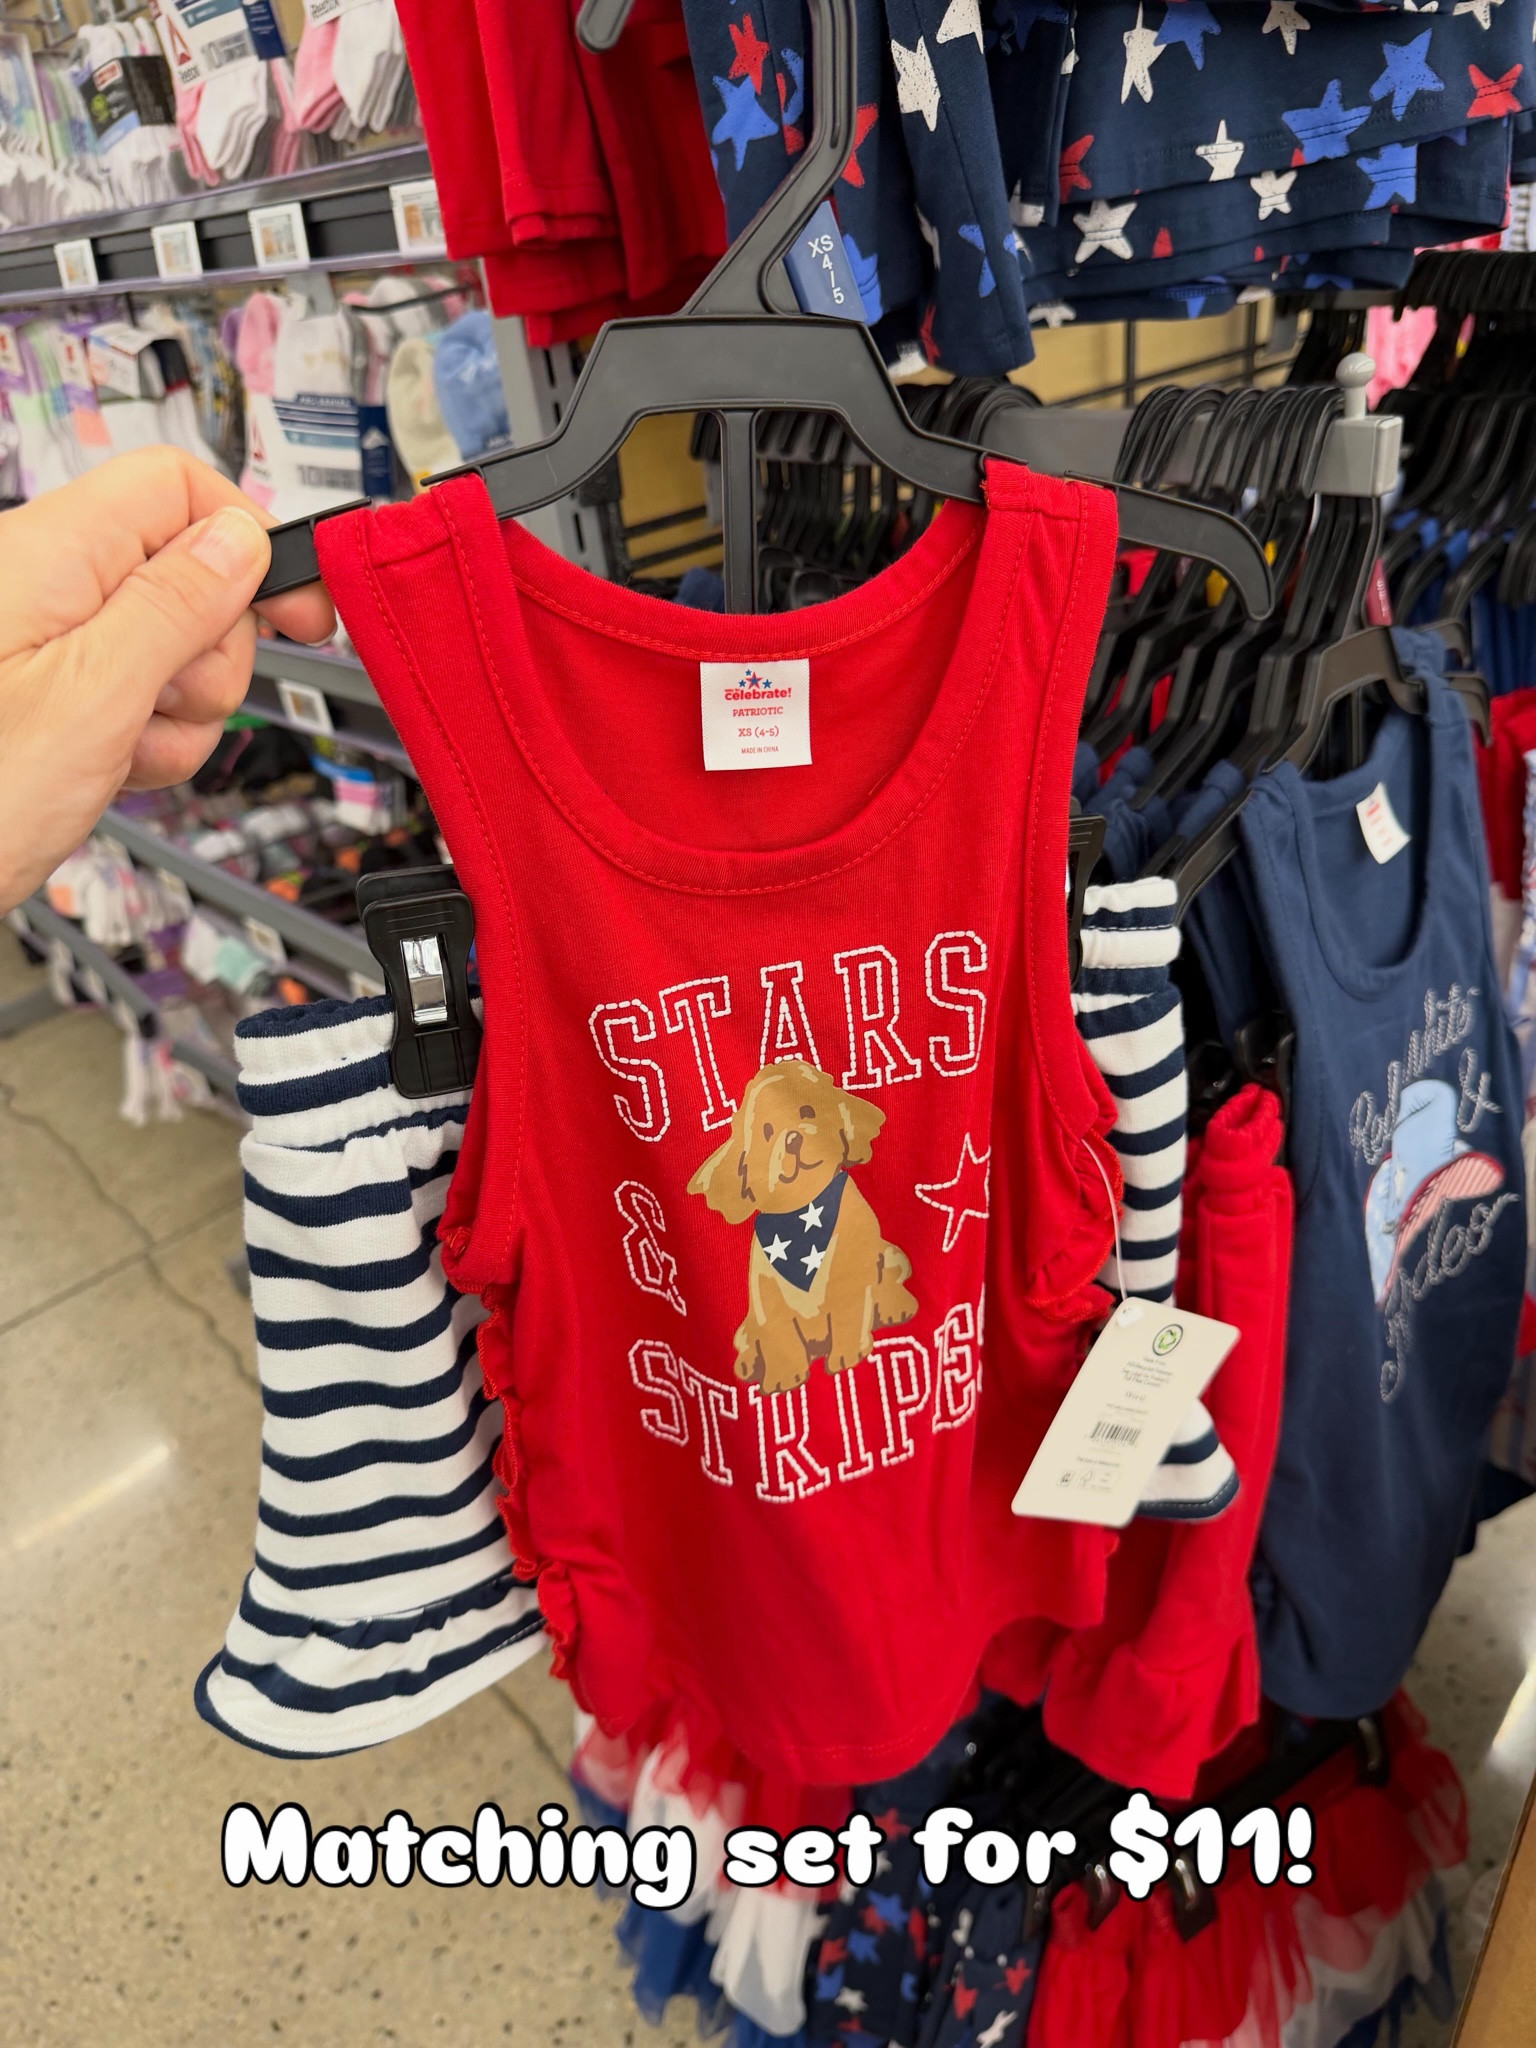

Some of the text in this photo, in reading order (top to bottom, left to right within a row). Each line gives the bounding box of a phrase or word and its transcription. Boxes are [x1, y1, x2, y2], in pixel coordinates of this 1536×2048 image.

[808, 234, 834, 258] XS
[822, 253, 833, 270] 4
[832, 287, 845, 304] 5
[724, 687, 791, 700] celebrate!
[732, 706, 784, 717] PATRIOTIC
[738, 725, 780, 738] XS (4-5)
[588, 930, 989, 1143] STARS
[614, 1180, 687, 1316] &
[627, 1283, 985, 1504] STRIPE
